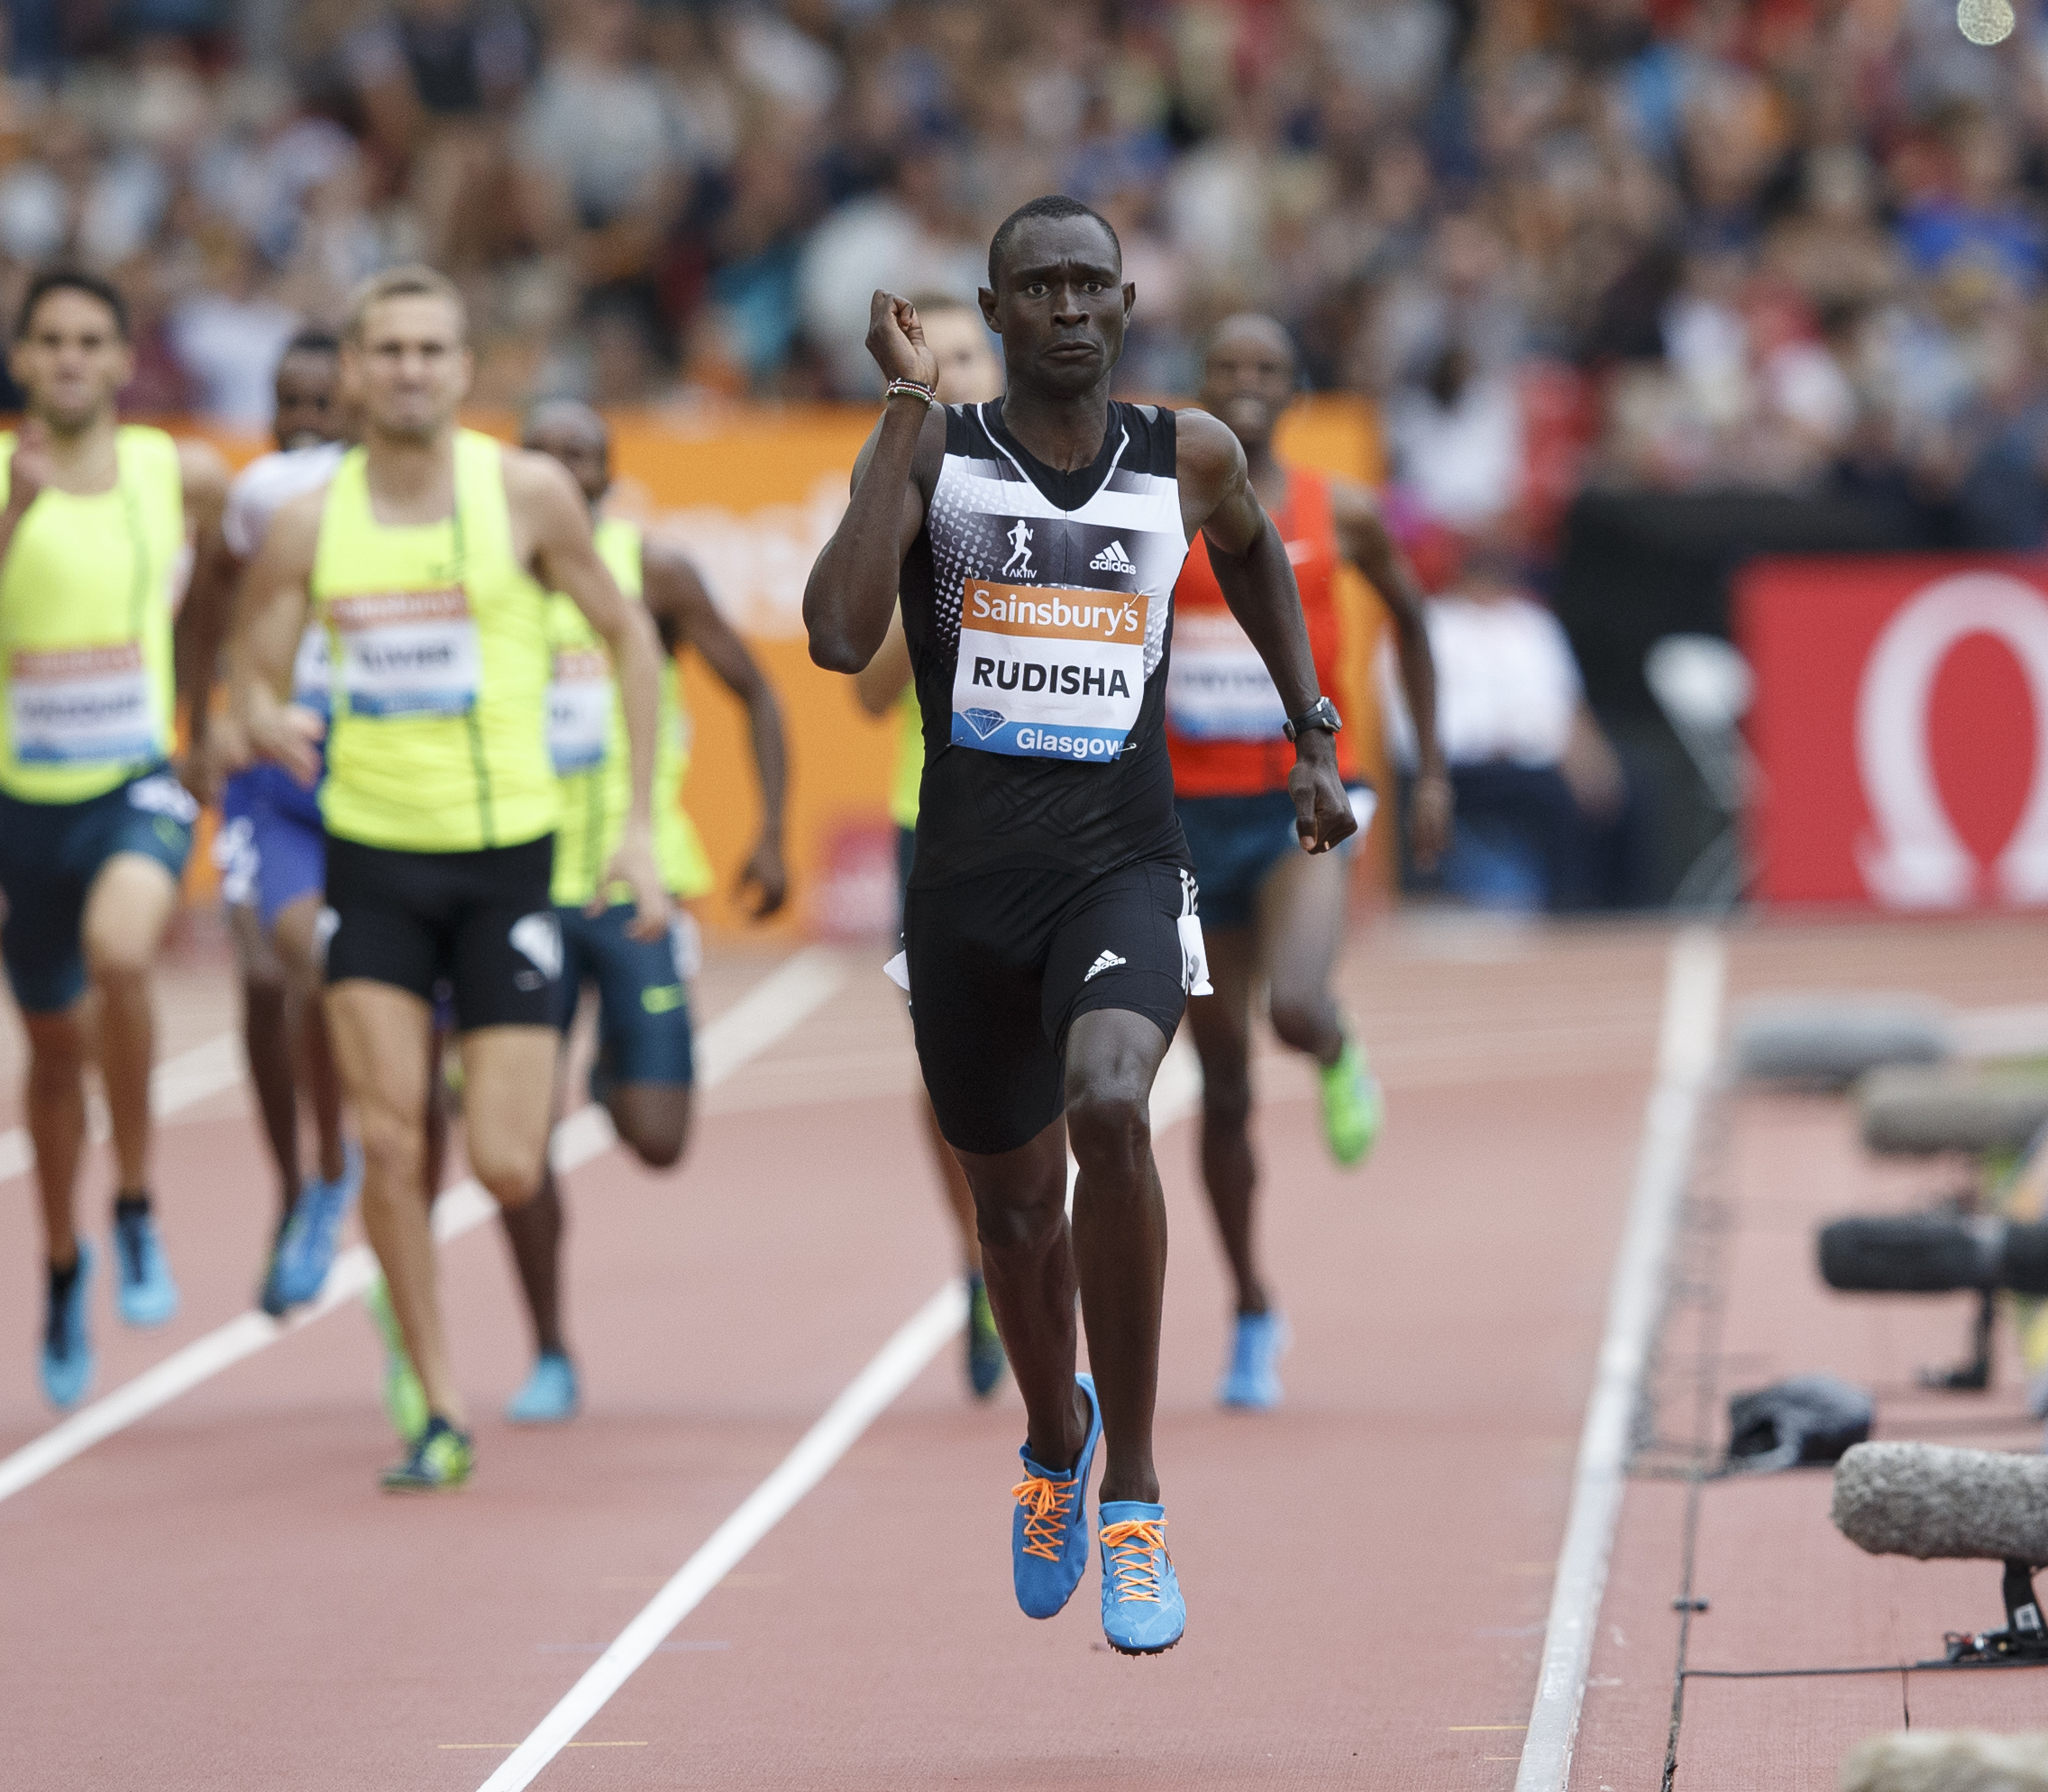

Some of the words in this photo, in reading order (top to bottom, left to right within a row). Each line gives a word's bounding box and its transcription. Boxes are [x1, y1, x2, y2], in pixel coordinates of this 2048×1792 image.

[1009, 569, 1037, 579] AKTIV
[1089, 558, 1137, 575] adidas
[972, 589, 1138, 635] Sainsbury's
[972, 656, 1130, 699] RUDISHA
[1016, 728, 1123, 758] Glasgow
[1084, 957, 1127, 982] adidas
